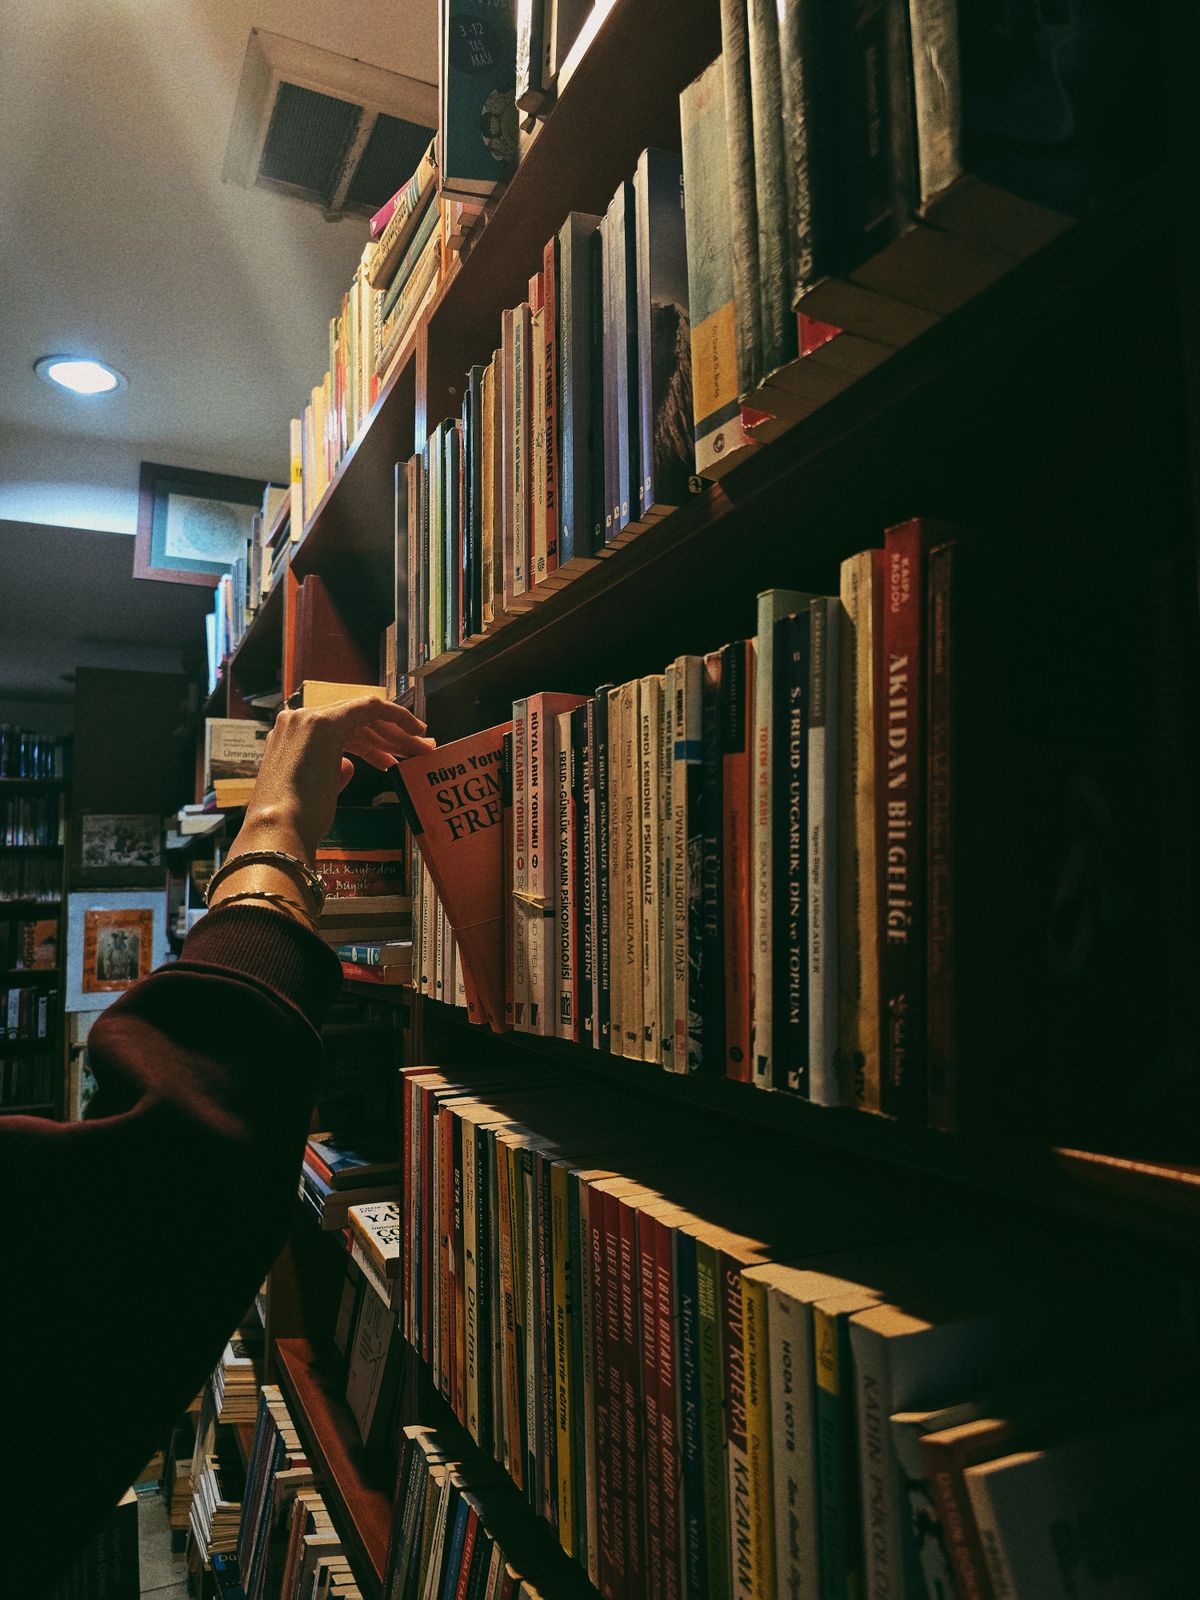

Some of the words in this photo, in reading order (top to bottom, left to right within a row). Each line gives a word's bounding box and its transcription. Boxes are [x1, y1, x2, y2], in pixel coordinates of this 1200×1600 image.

[459, 23, 484, 37] 3-12
[546, 416, 554, 483] FORMAT
[547, 491, 554, 509] AT
[790, 686, 802, 704] S.
[888, 653, 909, 789] AKILDAN
[515, 719, 524, 792] RÜYALARIN
[583, 746, 589, 758] S.
[599, 743, 605, 753] S.
[759, 727, 768, 767] TOTEM
[790, 708, 801, 769] FREUD
[427, 760, 467, 786] Rüya
[559, 751, 567, 782] FREUD
[759, 773, 768, 786] VE
[516, 797, 524, 852] YORUMU
[559, 791, 569, 835] GÜNLÜK
[600, 801, 608, 871] PSİKANALİZE
[759, 794, 768, 826] TABU
[558, 837, 569, 886] YAŞAMIN
[644, 824, 652, 905] PSİKANALİZ
[886, 800, 914, 945] BİLGELİĞE
[600, 905, 608, 935] GİRİŞ
[789, 882, 802, 916] DİN
[560, 889, 572, 980] PSİKOPATOLOJİSİ
[585, 923, 593, 982] ÜZERİNE
[789, 946, 800, 1024] TOPLUM
[592, 1228, 602, 1287] DOĞAN
[467, 1285, 476, 1378] Dürtme
[505, 1292, 514, 1332] BENİM
[608, 1279, 619, 1341] ORTAYLI
[623, 1284, 633, 1345] ORTAYLI
[726, 1271, 743, 1341] SHIV
[747, 1297, 755, 1349] NEVZAT
[557, 1303, 566, 1384] ALTERNATİF
[642, 1302, 656, 1369] ORTAYLI
[659, 1318, 672, 1388] ORTAYLI
[609, 1366, 621, 1394] BİR
[729, 1344, 746, 1438] KHERA
[749, 1351, 758, 1408] TARHAN
[782, 1340, 792, 1394] HODA
[559, 1385, 567, 1433] EĞİTİM
[646, 1394, 657, 1426] BİR
[661, 1413, 674, 1447] BİR
[785, 1401, 796, 1452] KOTB
[611, 1444, 623, 1491] NASIL
[627, 1454, 637, 1497] NASIL
[647, 1427, 659, 1477] ÖMÜR
[661, 1447, 675, 1500] ÖMÜR
[648, 1479, 660, 1529] NASIL
[662, 1500, 676, 1552] NASIL
[734, 1458, 752, 1594] KAZANAN
